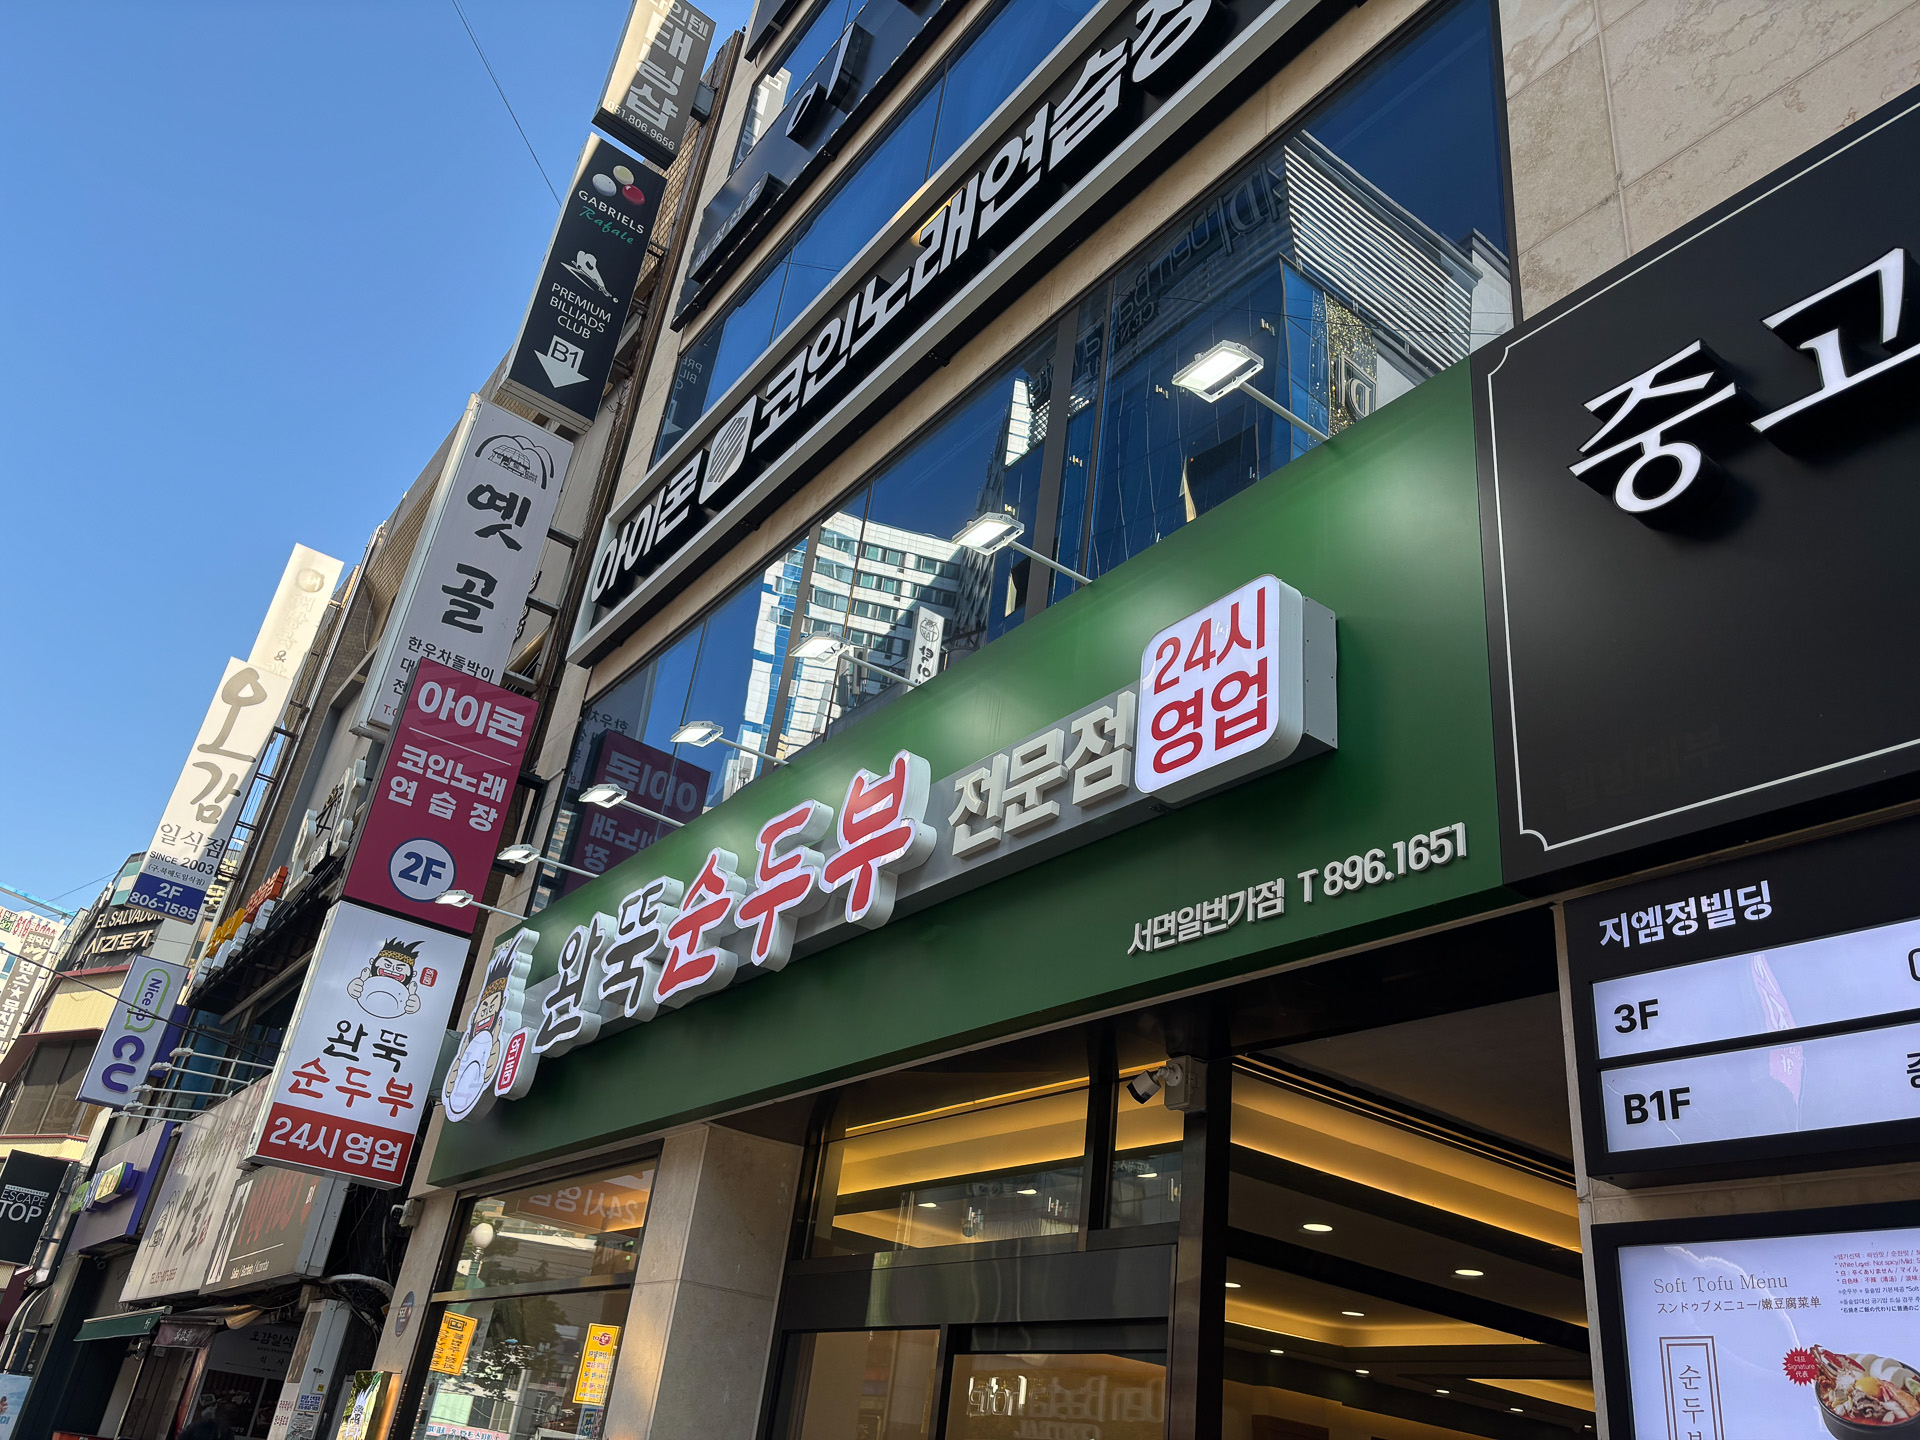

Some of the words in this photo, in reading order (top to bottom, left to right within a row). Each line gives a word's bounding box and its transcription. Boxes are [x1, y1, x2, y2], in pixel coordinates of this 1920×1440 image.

[626, 11, 694, 131] 태닝샵
[607, 101, 675, 150] 051.806.9656
[578, 190, 645, 235] GABRIELS
[579, 206, 635, 246] Rafale
[549, 297, 606, 334] BILLIADS
[551, 283, 612, 324] PREMIUM
[557, 315, 591, 341] CLUB
[550, 339, 581, 369] B1
[1566, 247, 1920, 513] 중고
[591, 449, 704, 602] 아이론
[441, 483, 532, 634] 옛골
[408, 636, 495, 685] 한우차돌박이
[1153, 586, 1266, 696] 24시
[417, 681, 525, 747] 아이론
[1151, 656, 1268, 774] 영업
[190, 667, 268, 825] 오감
[397, 744, 508, 803] 코인노래
[947, 690, 1138, 859] 전문점
[149, 850, 179, 865] SINCE
[181, 857, 215, 876] 2003
[160, 823, 226, 859] 일식점
[156, 882, 184, 899] 2F
[398, 851, 447, 887] 2F
[1127, 877, 1286, 955] 서면일번가점
[1297, 868, 1319, 903] T
[1323, 821, 1467, 897] 896.1651
[95, 913, 108, 929] EL
[129, 891, 198, 920] 806-1585
[1599, 880, 1773, 948] 지엠정빌딩
[142, 977, 163, 1006] Nice
[1613, 998, 1659, 1034] 3F
[101, 1035, 145, 1093] CU
[323, 1020, 408, 1073] 완뚝
[288, 1057, 414, 1118] 순두부
[1623, 1086, 1691, 1125] B1F
[1, 1189, 48, 1208] ESCAPE
[1653, 1278, 1688, 1294] Soft
[1692, 1275, 1734, 1293] Tofu
[1740, 1274, 1789, 1290] Menu
[250, 1331, 298, 1348] 오감일식
